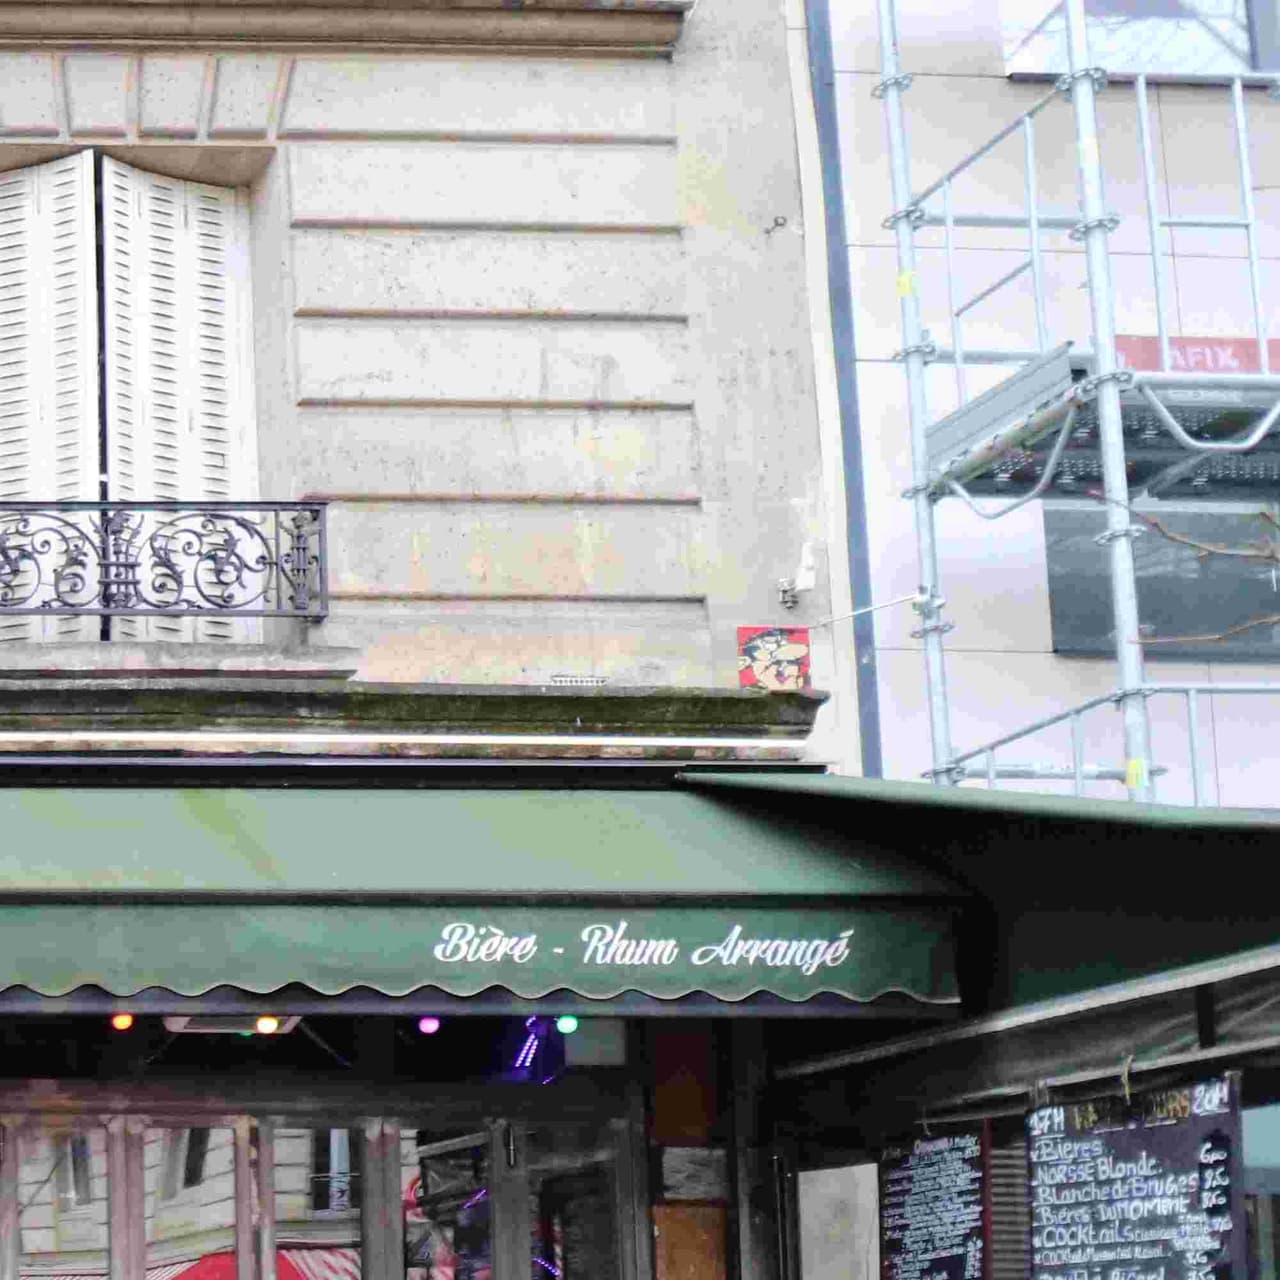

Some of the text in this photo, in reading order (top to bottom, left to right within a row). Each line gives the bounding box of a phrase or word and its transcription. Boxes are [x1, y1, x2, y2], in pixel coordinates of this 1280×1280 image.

[434, 922, 539, 964] Bière
[581, 920, 679, 965] Rhum
[690, 925, 855, 976] Arrangé
